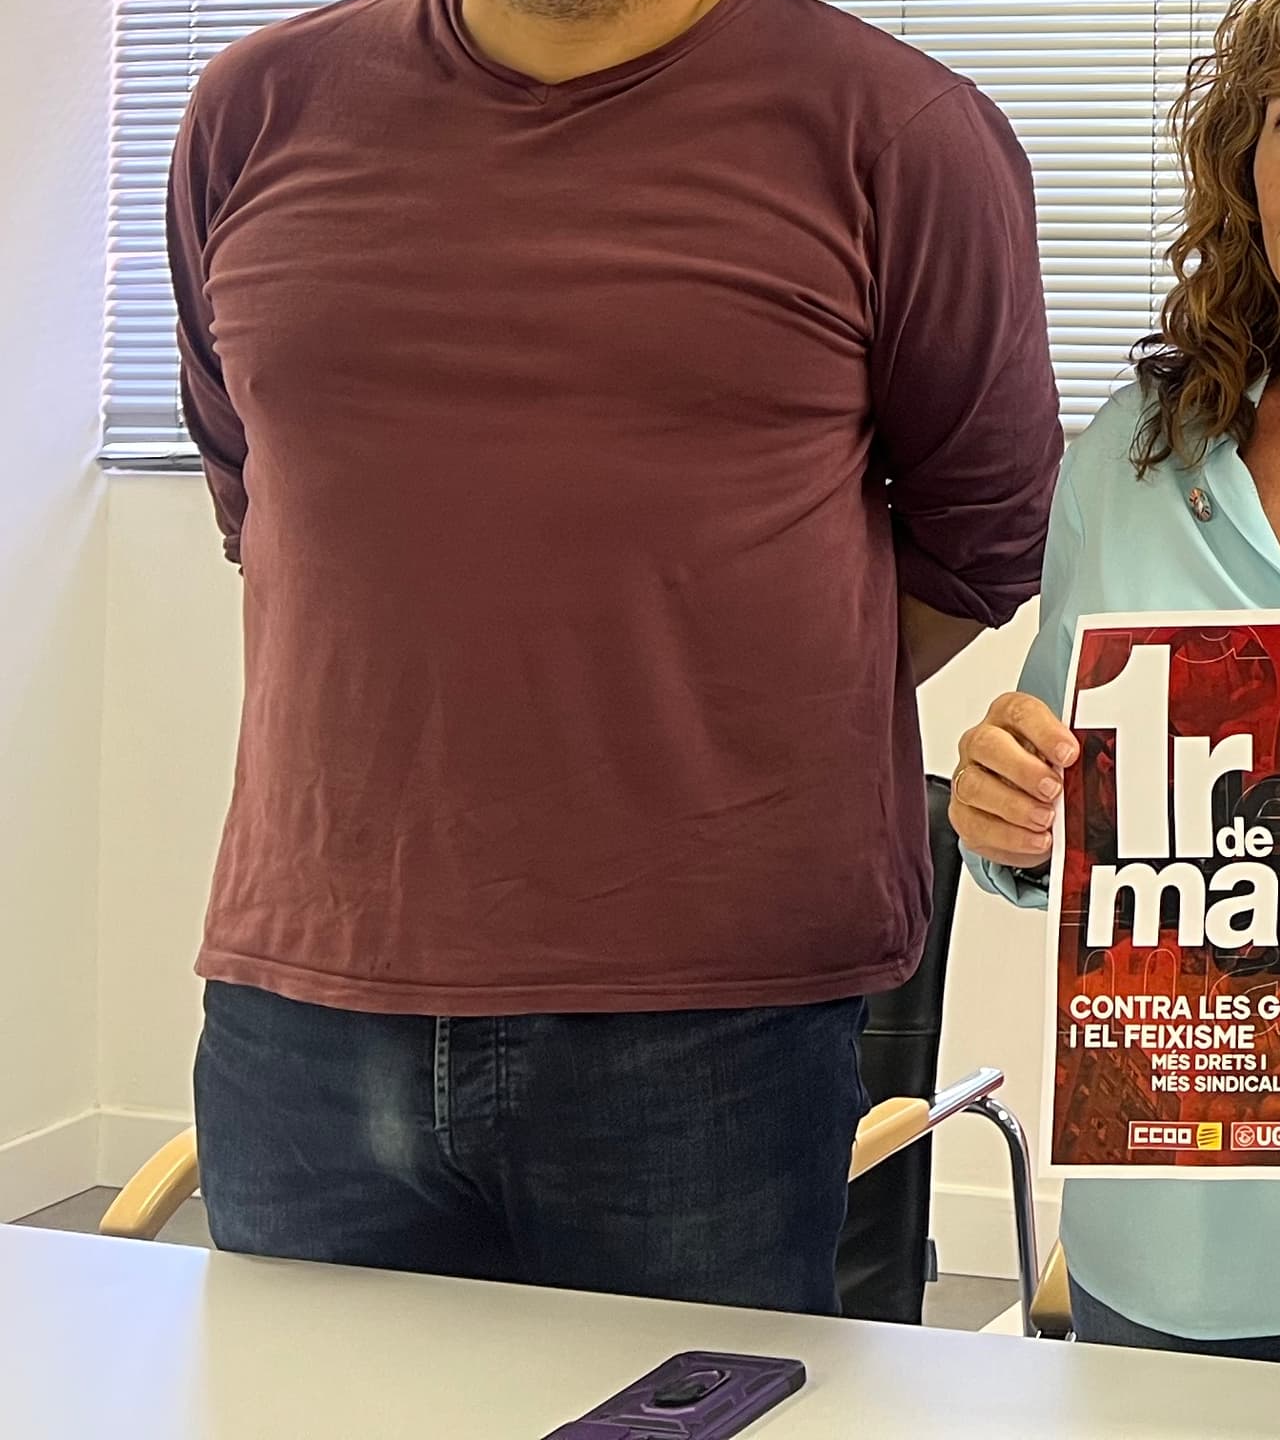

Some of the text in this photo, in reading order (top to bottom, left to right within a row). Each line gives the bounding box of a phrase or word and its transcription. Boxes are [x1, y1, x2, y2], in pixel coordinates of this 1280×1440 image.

[1073, 643, 1274, 859] 1r de
[1069, 995, 1192, 1020] CONTRA
[1197, 995, 1251, 1020] LES
[1069, 1024, 1255, 1049] I EL FEIXISME
[1151, 1049, 1267, 1071] MÉS DRETS I
[1151, 1071, 1190, 1092] MÉS
[1133, 1126, 1192, 1145] CCOO
